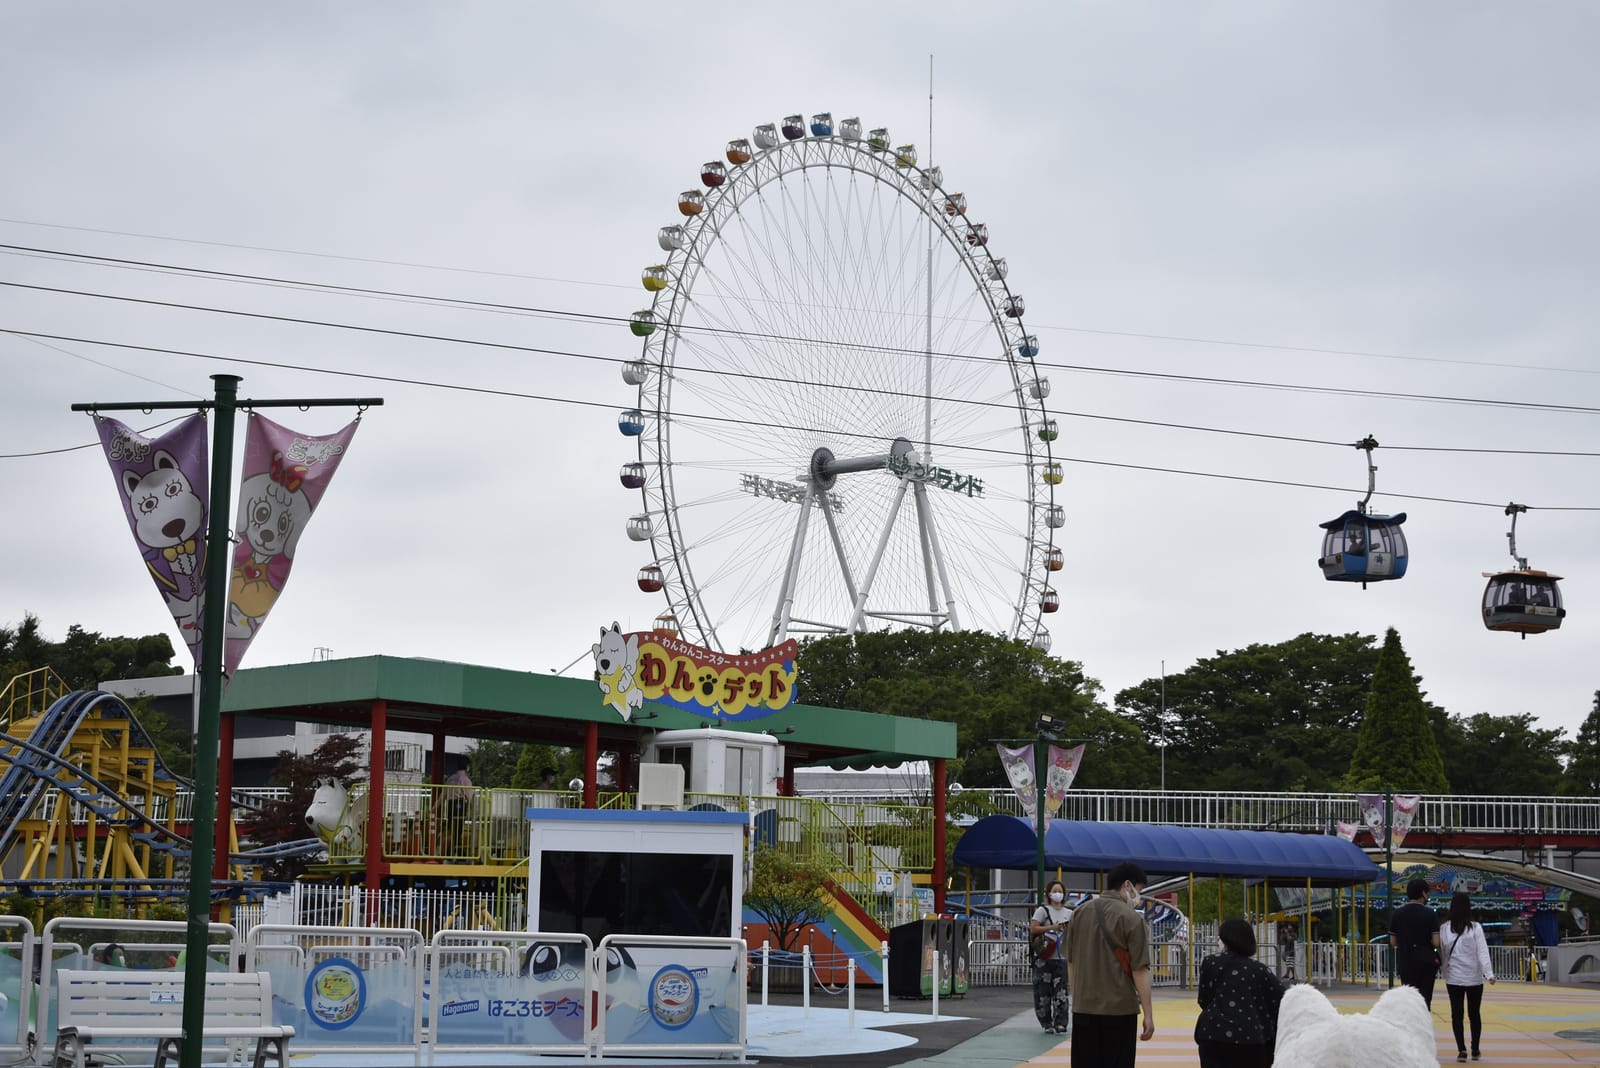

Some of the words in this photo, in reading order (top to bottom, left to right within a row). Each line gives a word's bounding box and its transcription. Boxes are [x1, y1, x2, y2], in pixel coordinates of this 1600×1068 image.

[662, 637, 731, 665] わんわんコースター
[488, 998, 580, 1017] はごろもフーズ
